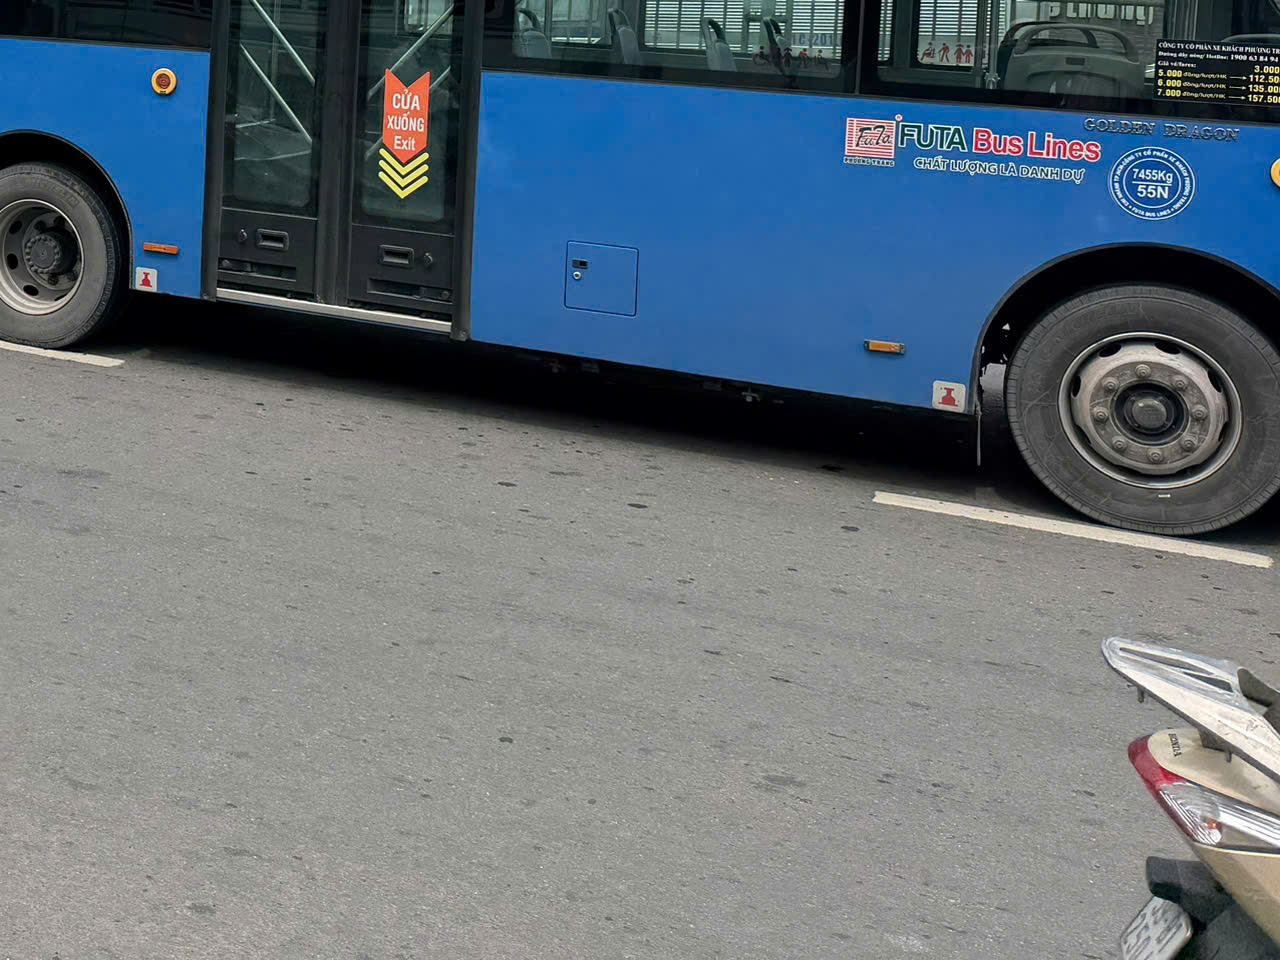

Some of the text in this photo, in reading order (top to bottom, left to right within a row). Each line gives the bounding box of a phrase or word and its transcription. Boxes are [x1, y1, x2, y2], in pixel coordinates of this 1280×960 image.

[1158, 42, 1176, 50] CÔNG
[1245, 46, 1271, 54] PHƯƠNG
[1158, 69, 1182, 78] 5.000
[1249, 74, 1280, 84] 112.50
[1157, 78, 1182, 88] 6.000
[1248, 84, 1280, 94] 135.00
[391, 88, 421, 111] CỬA
[1157, 88, 1182, 97] 7.000
[1247, 94, 1280, 104] 157.50
[386, 112, 425, 132] XUỐNG
[1084, 118, 1241, 142] GOLDEN DRAGON
[393, 135, 417, 151] Exit
[898, 122, 1102, 163] FUTA Bus Lines
[872, 158, 896, 168] TRANG
[914, 154, 1086, 185] CHẤT LƯỢNG LÀ DANH DỰ
[1132, 168, 1174, 184] 7455Kg
[1136, 184, 1169, 199] 55N
